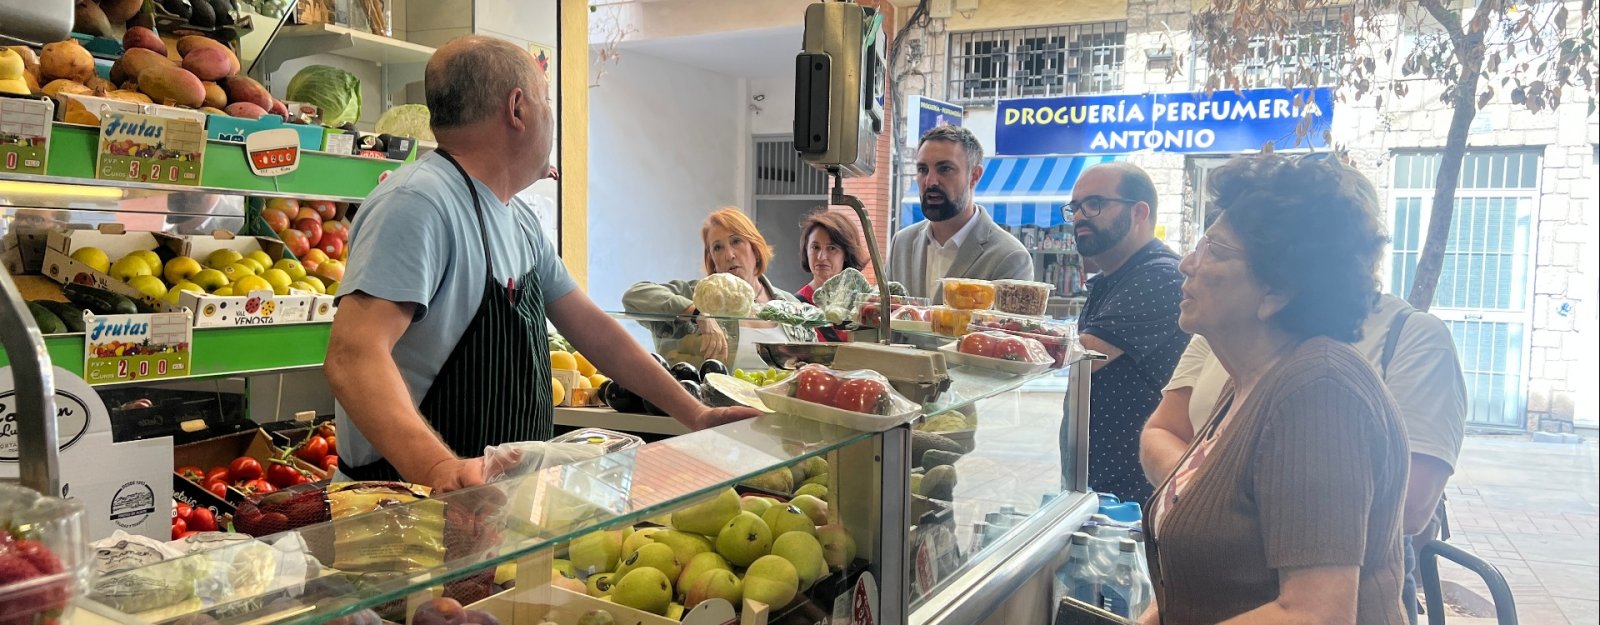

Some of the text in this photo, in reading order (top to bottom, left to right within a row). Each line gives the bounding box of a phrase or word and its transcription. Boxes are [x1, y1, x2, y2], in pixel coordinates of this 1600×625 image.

[1005, 100, 1144, 125] DROGUERÍA
[105, 114, 163, 138] Frutas
[1090, 128, 1215, 150] ANTONIO
[91, 317, 149, 341] Frutas
